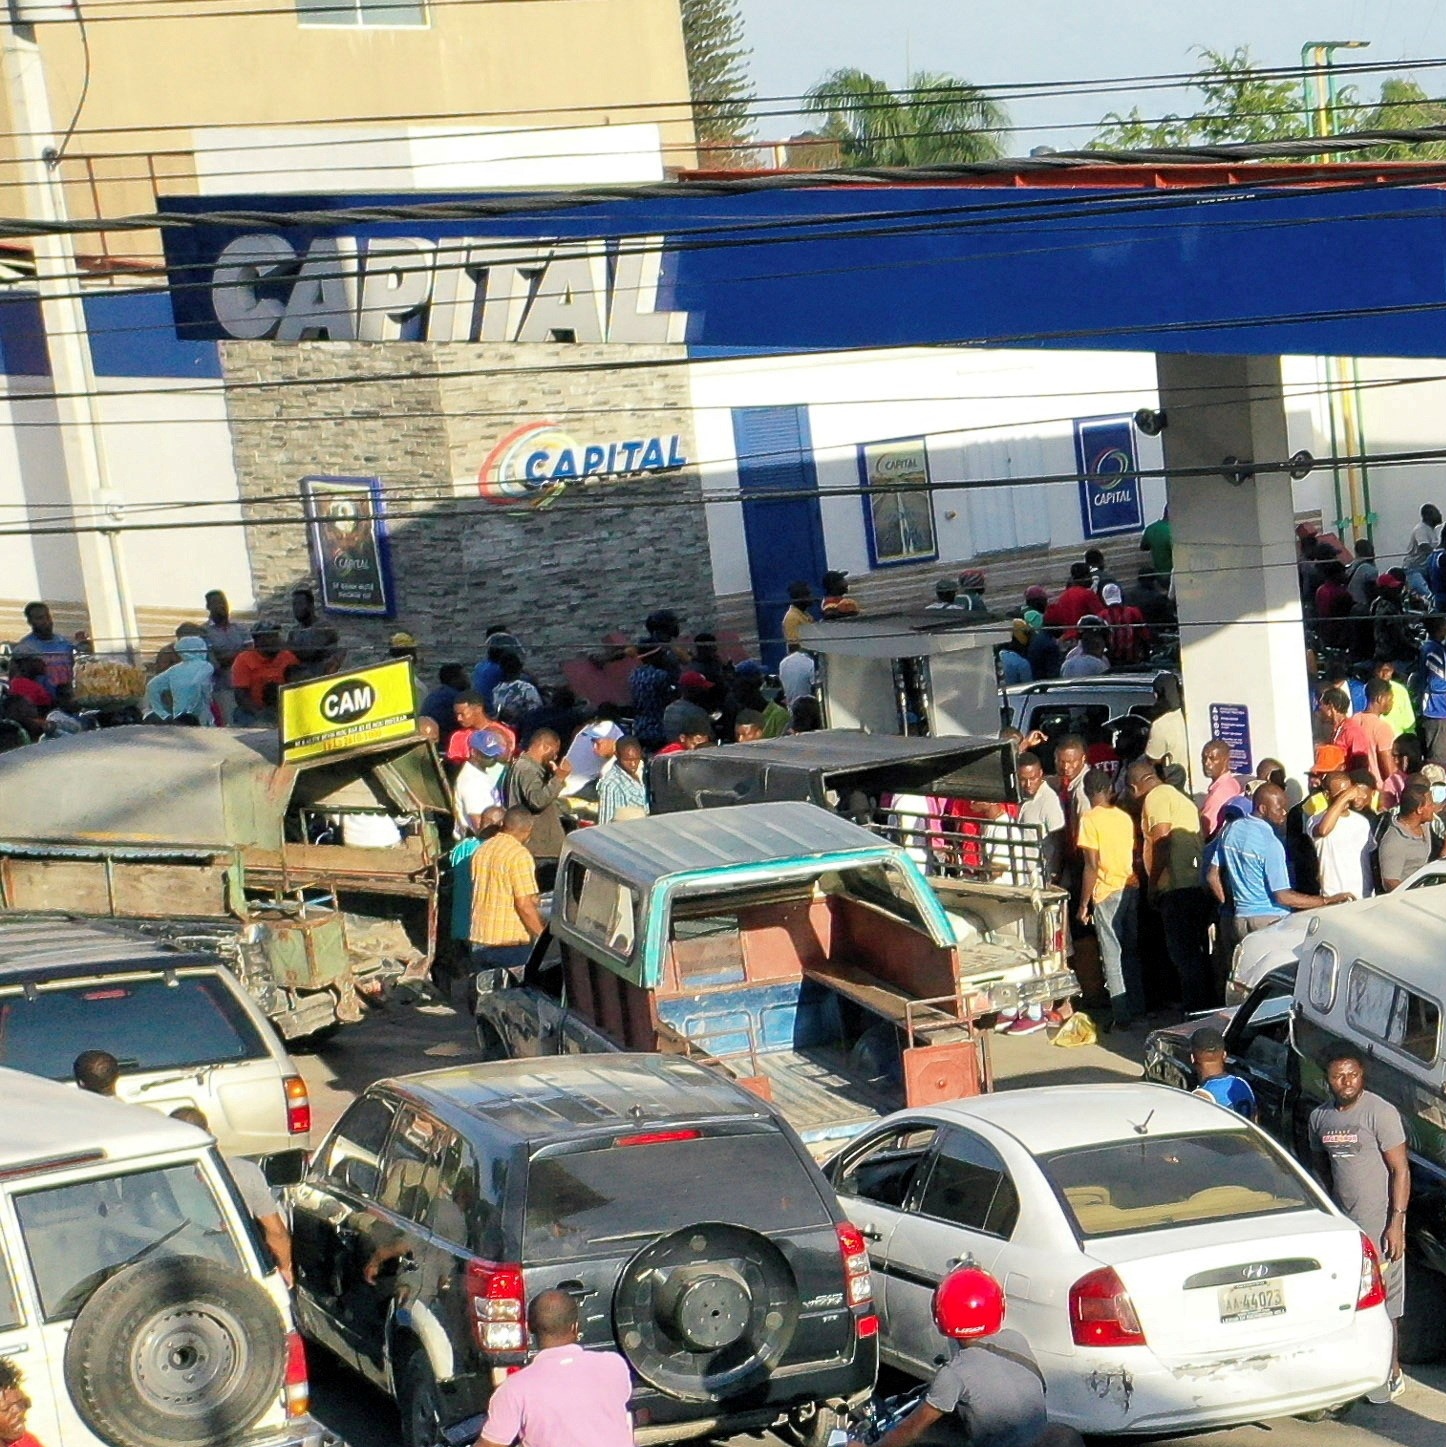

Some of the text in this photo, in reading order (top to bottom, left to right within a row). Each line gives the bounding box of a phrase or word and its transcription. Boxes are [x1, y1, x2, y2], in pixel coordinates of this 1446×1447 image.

[212, 234, 687, 343] CAPITAL
[525, 434, 687, 484] CAPITAL
[885, 455, 917, 470] CAPITAL
[1094, 489, 1132, 507] CAPITAL
[324, 686, 371, 718] CAM
